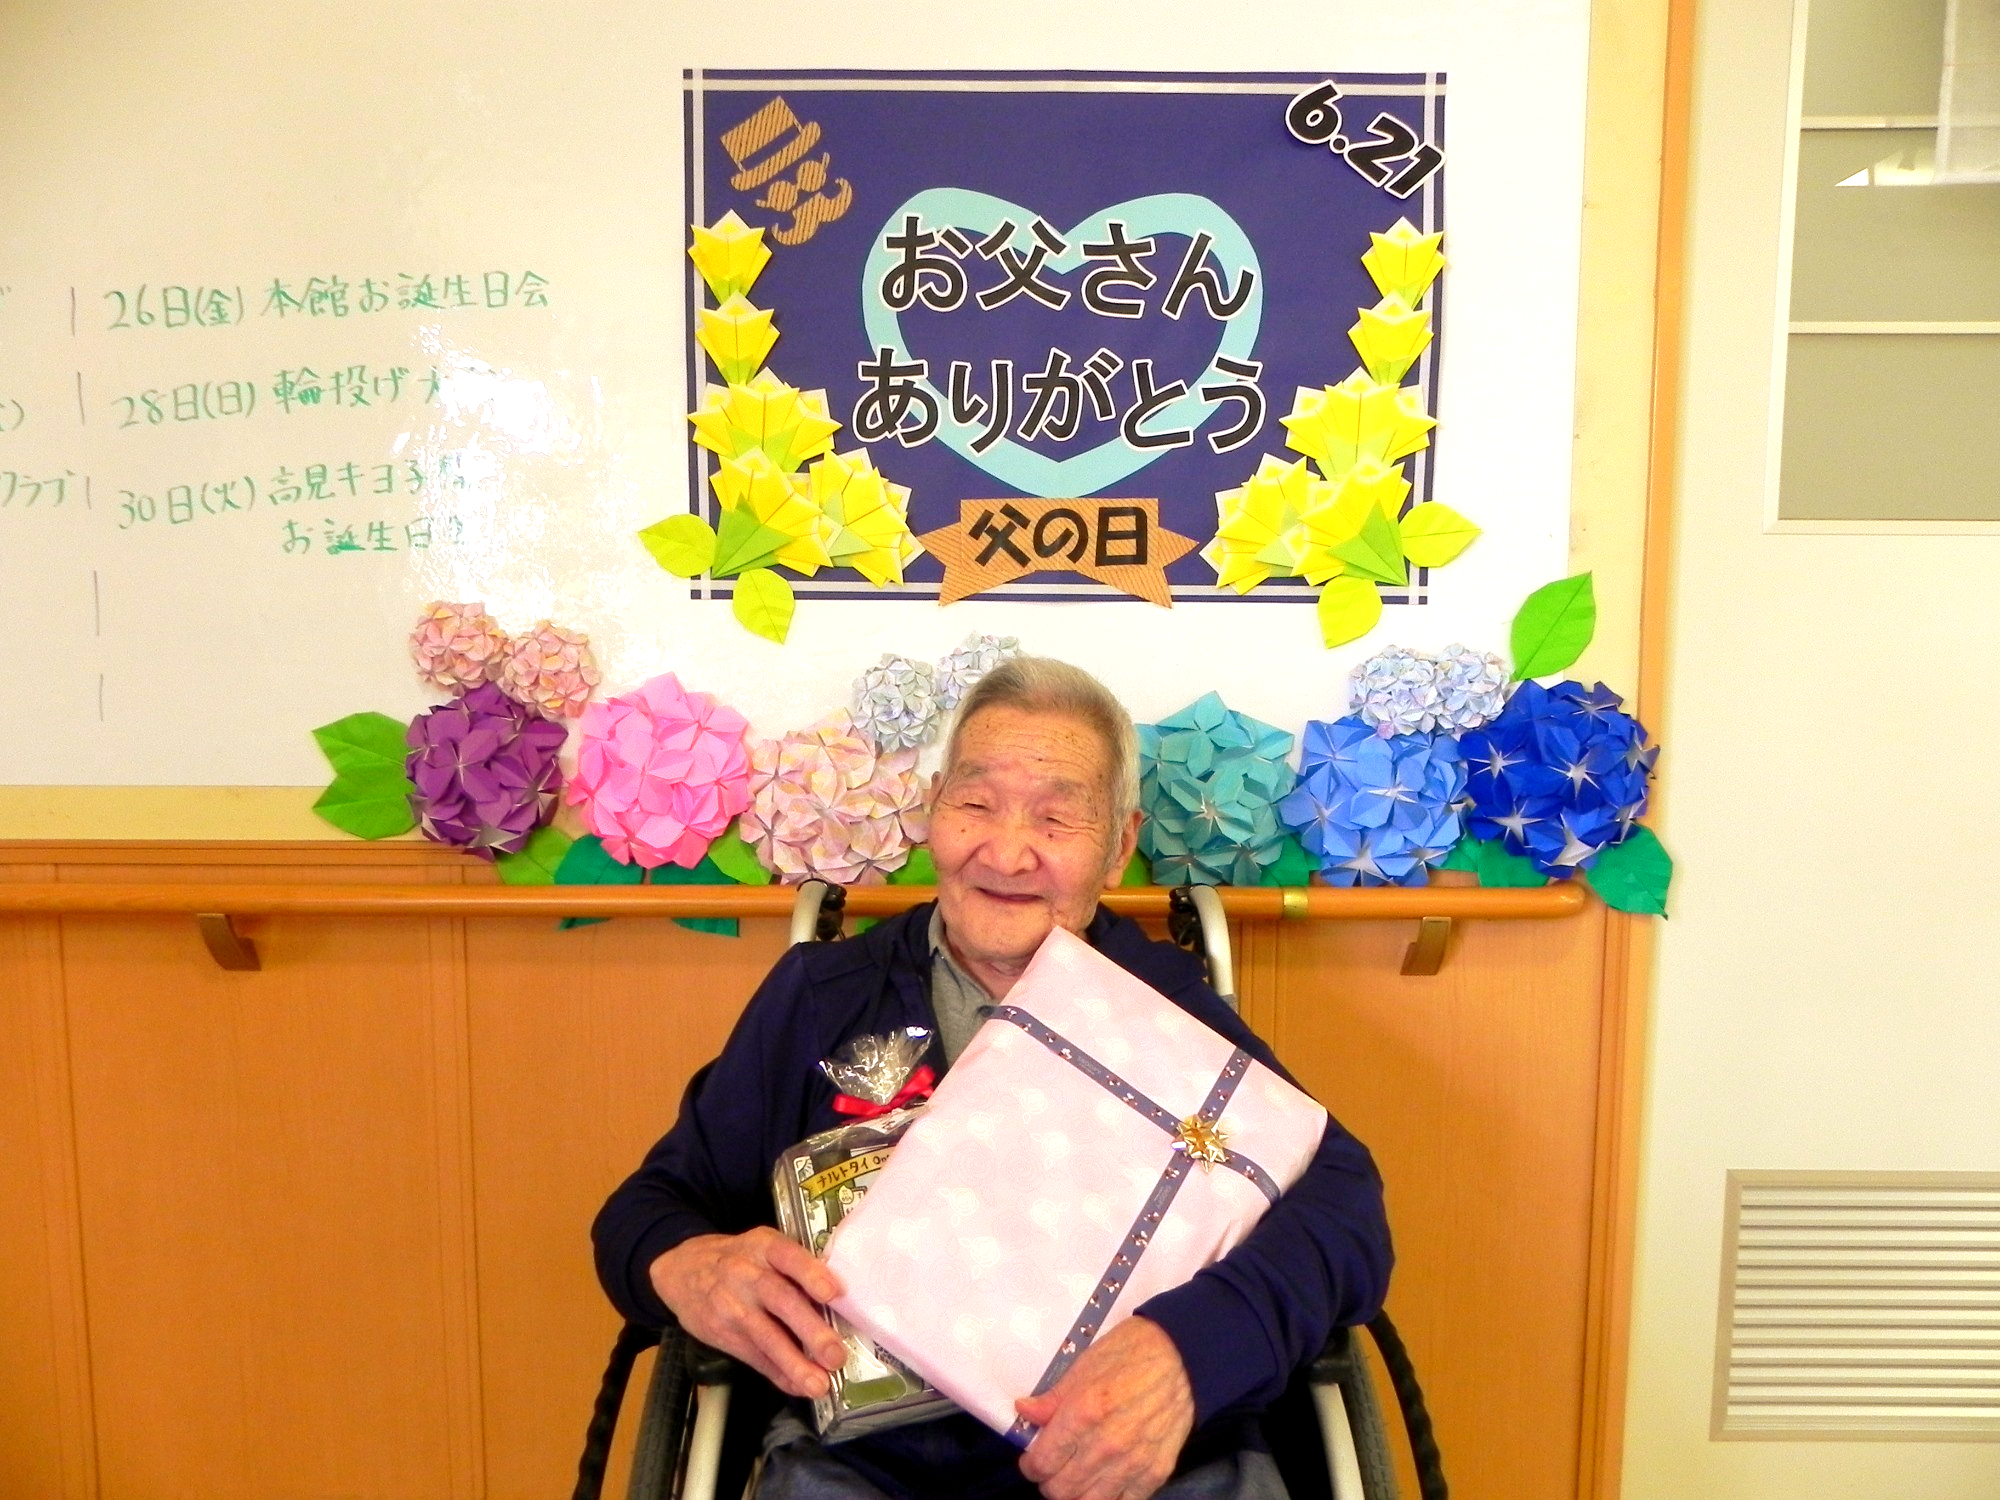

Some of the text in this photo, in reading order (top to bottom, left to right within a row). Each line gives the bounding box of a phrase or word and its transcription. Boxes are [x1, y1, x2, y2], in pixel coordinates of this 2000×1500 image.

[1284, 79, 1447, 200] 6.21
[103, 270, 550, 329] 26日(金) 本館お誕生日会
[879, 214, 1257, 321] お父さん
[112, 364, 498, 429] 28日(日) 輪投げ大
[852, 346, 1267, 455] ありがとう
[117, 475, 256, 530] 30日(火)
[966, 502, 1149, 569] 父の日
